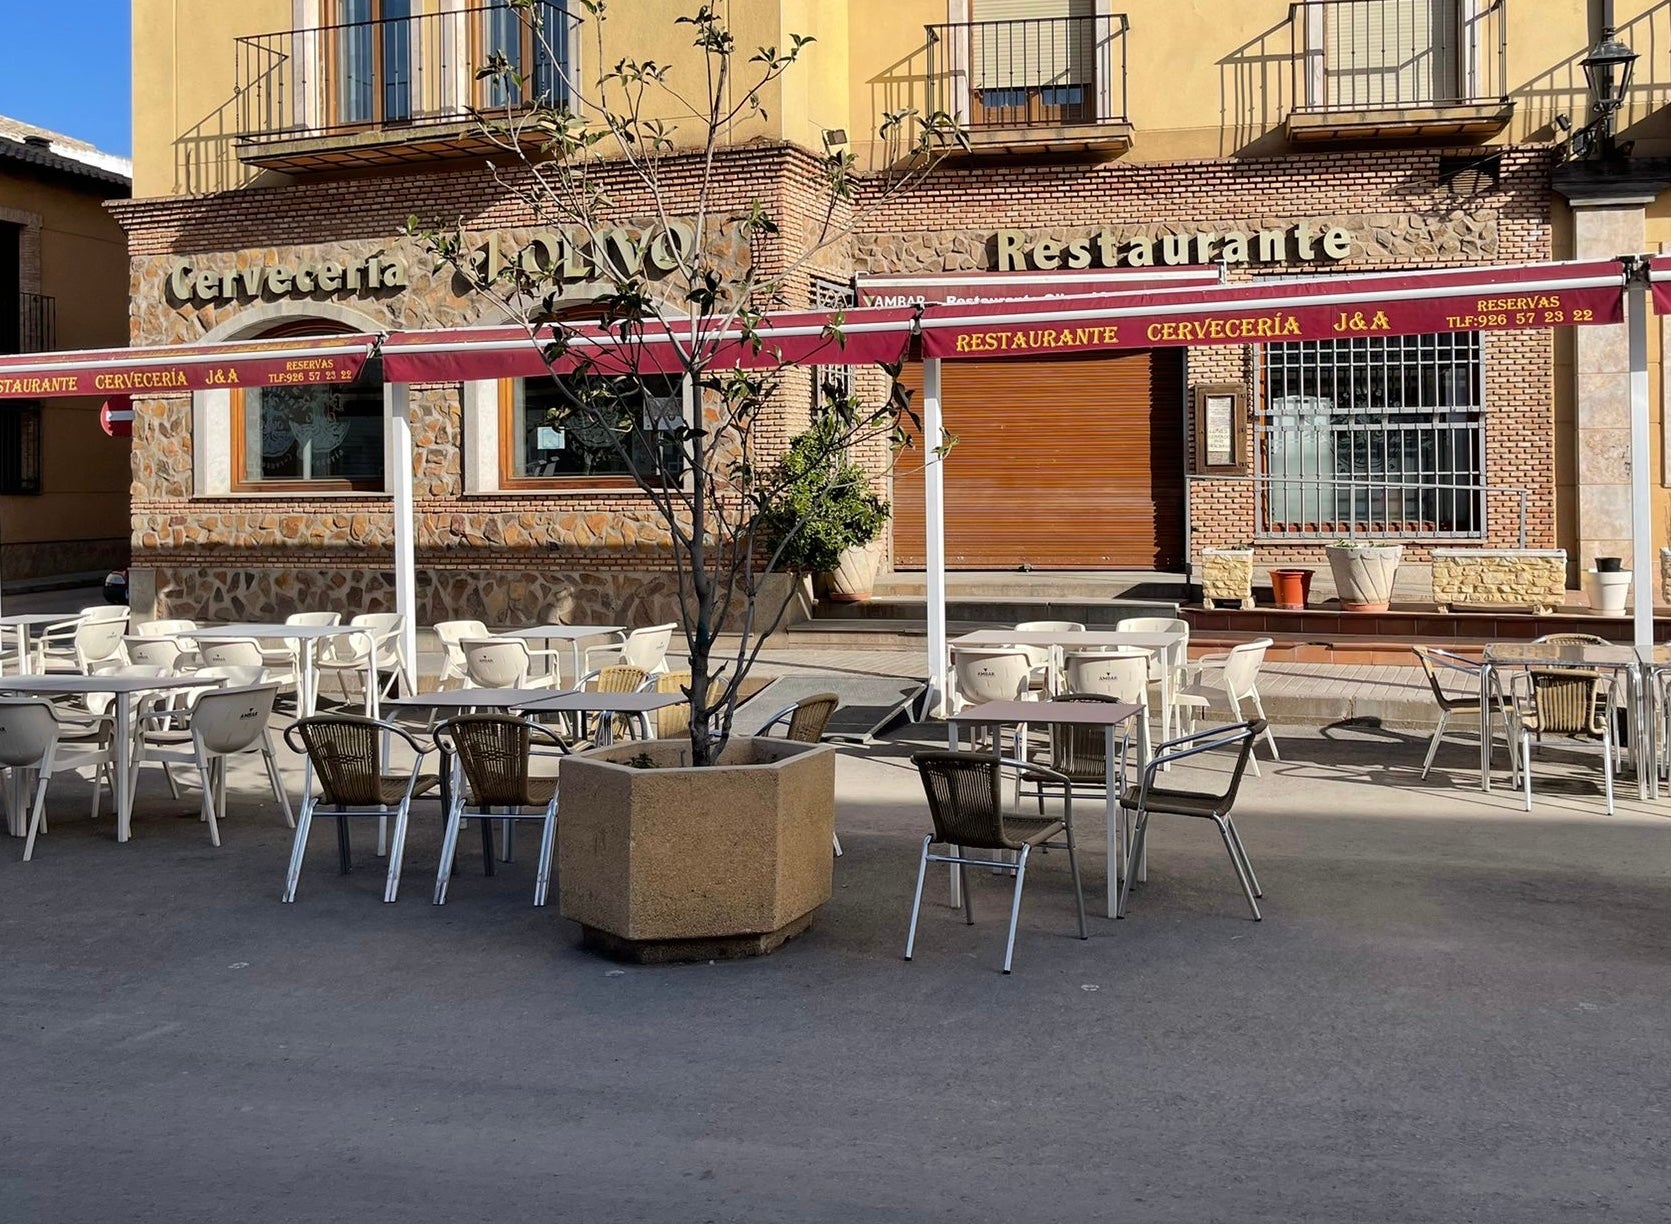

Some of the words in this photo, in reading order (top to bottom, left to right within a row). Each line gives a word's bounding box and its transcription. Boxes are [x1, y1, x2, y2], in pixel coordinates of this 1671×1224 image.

[997, 223, 1351, 273] Restaurante
[171, 251, 409, 300] Cervecería
[1477, 295, 1560, 312] RESERVAS
[1446, 314, 1507, 328] TLF:926
[1515, 312, 1536, 325] 57
[1544, 310, 1564, 323] 23
[1573, 309, 1594, 322] 22
[956, 326, 1120, 352] RESTAURANTE
[1146, 312, 1302, 342] CERVECERÍA
[1333, 310, 1392, 332] J&A
[286, 359, 334, 371] RESERVAS
[95, 367, 189, 390] CERVECERÍA
[205, 368, 240, 385] J&A
[268, 372, 305, 383] TLF:926
[308, 371, 321, 381] 57
[325, 370, 337, 380] 23
[340, 369, 352, 379] 22
